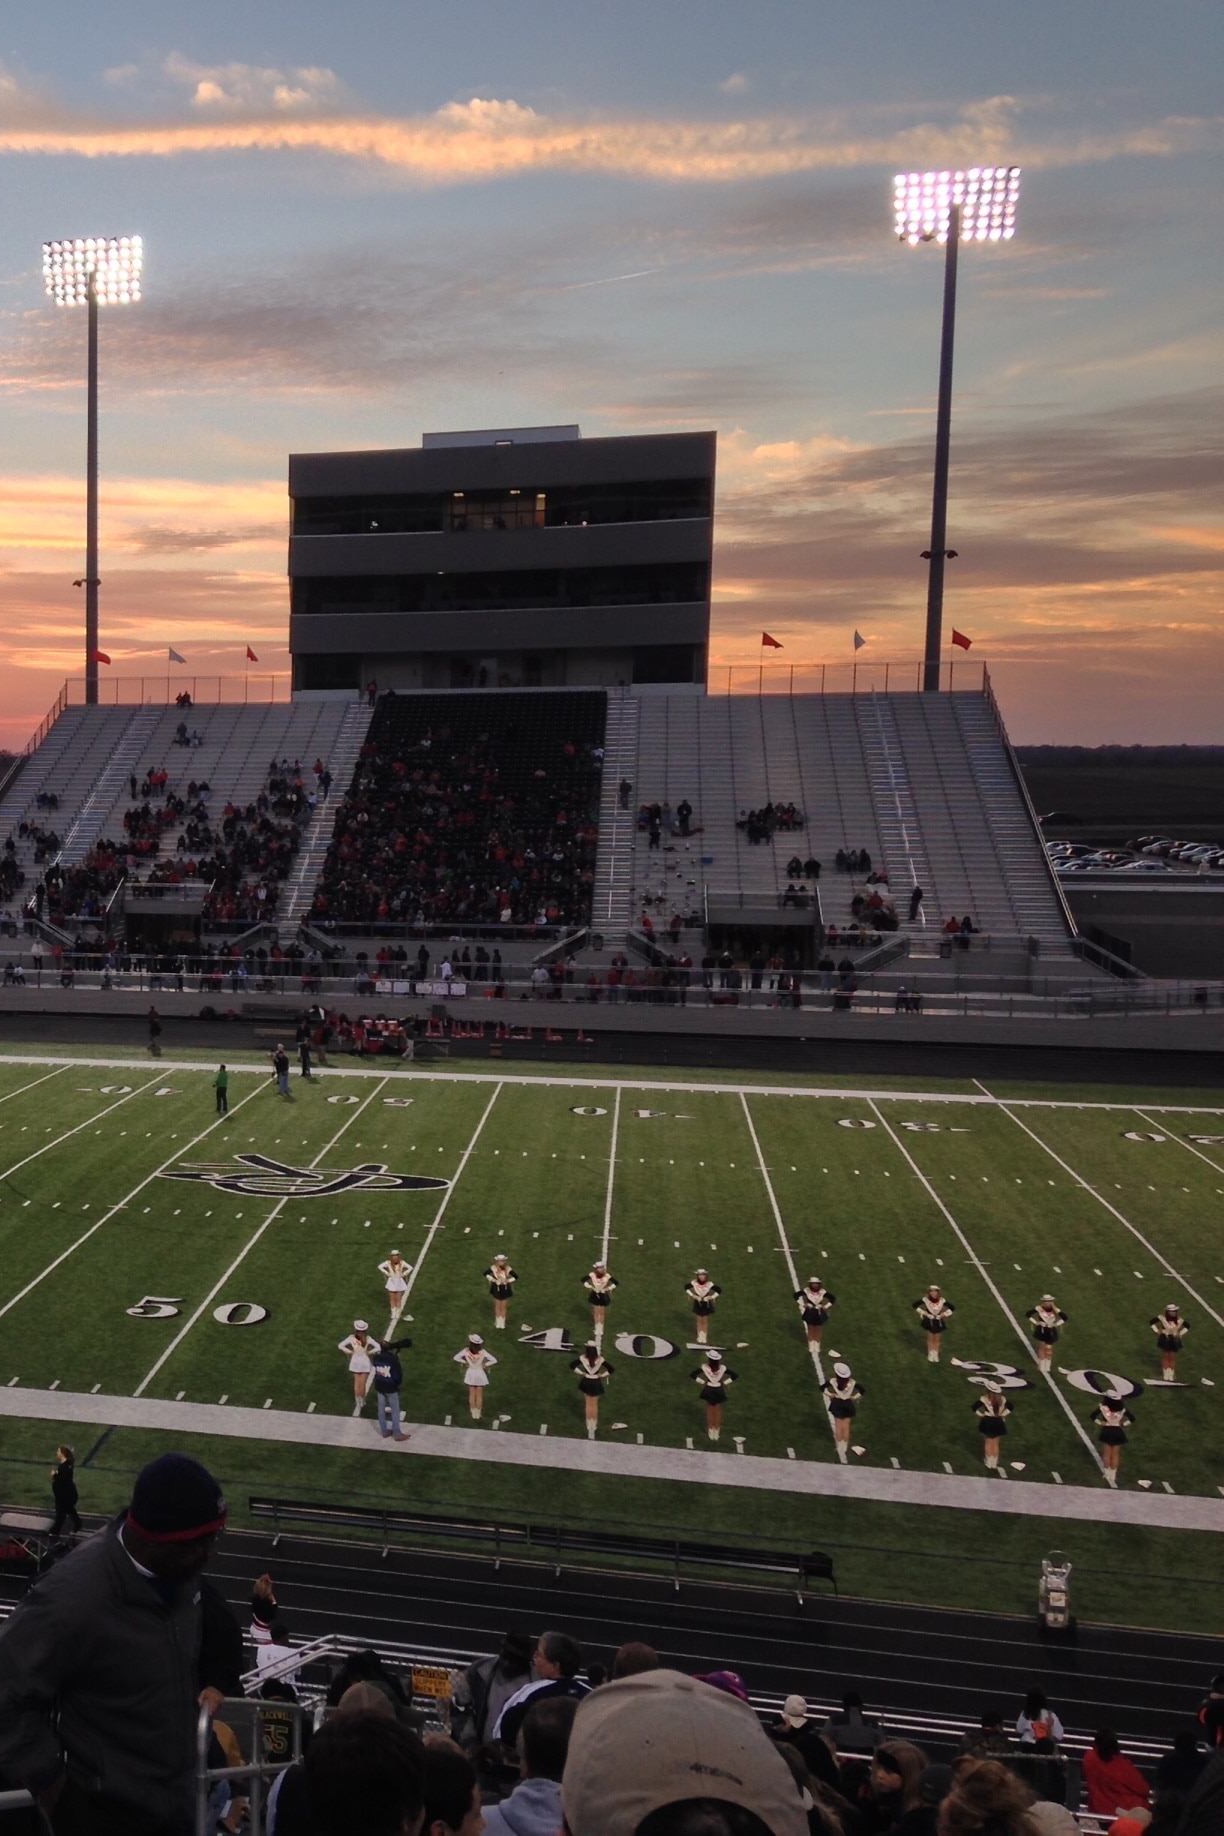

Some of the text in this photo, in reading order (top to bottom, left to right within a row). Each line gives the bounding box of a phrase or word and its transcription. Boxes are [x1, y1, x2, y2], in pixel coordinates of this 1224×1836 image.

[125, 1295, 272, 1326] 50
[516, 1326, 681, 1360] 40
[964, 1359, 1145, 1400] 30
[412, 1667, 449, 1680] CAUTION
